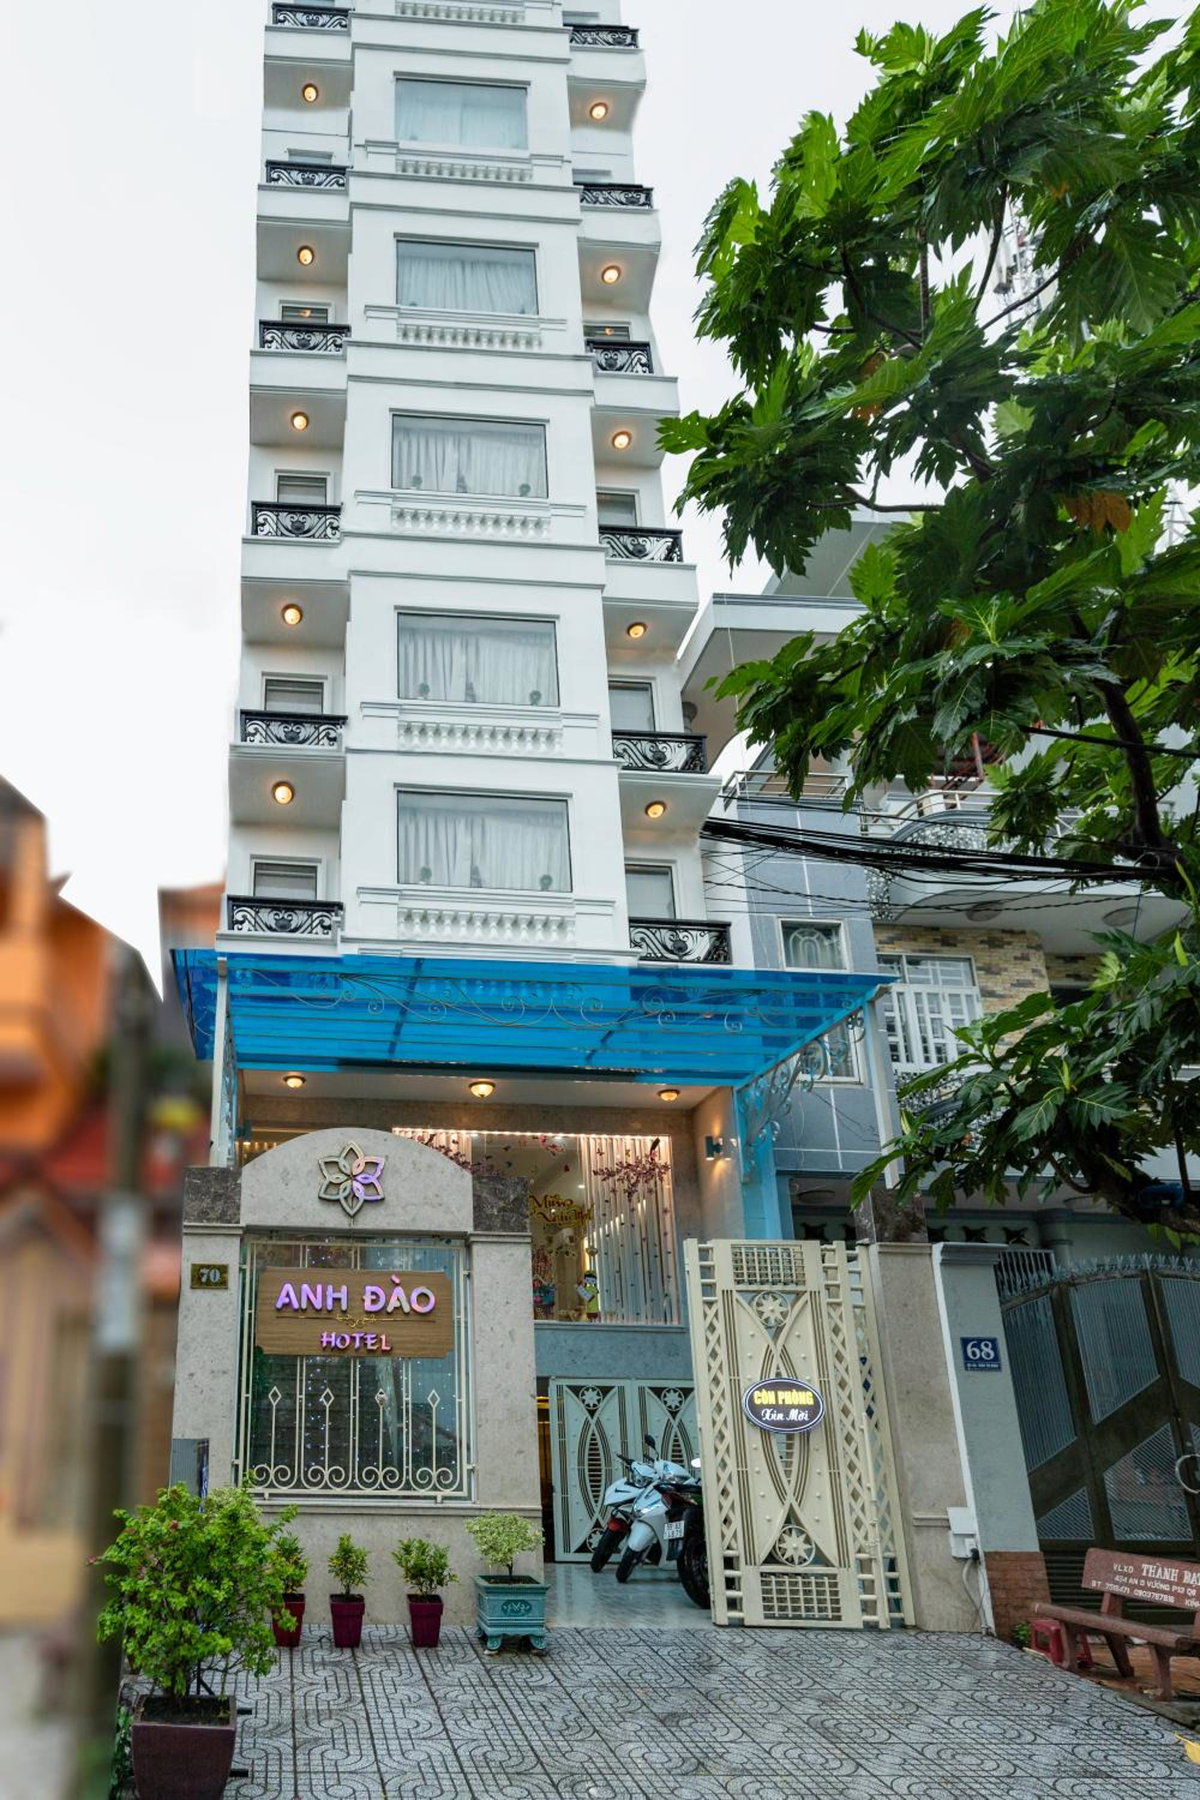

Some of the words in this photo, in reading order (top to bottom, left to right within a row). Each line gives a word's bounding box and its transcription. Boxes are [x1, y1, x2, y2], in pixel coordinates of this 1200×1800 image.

[200, 1268, 220, 1283] 70
[275, 1282, 348, 1312] ANH
[362, 1274, 436, 1314] ĐÀO
[320, 1331, 392, 1352] HOTEL
[966, 1340, 995, 1360] 68
[777, 1388, 815, 1405] PHÒNG
[761, 1408, 784, 1421] Xin
